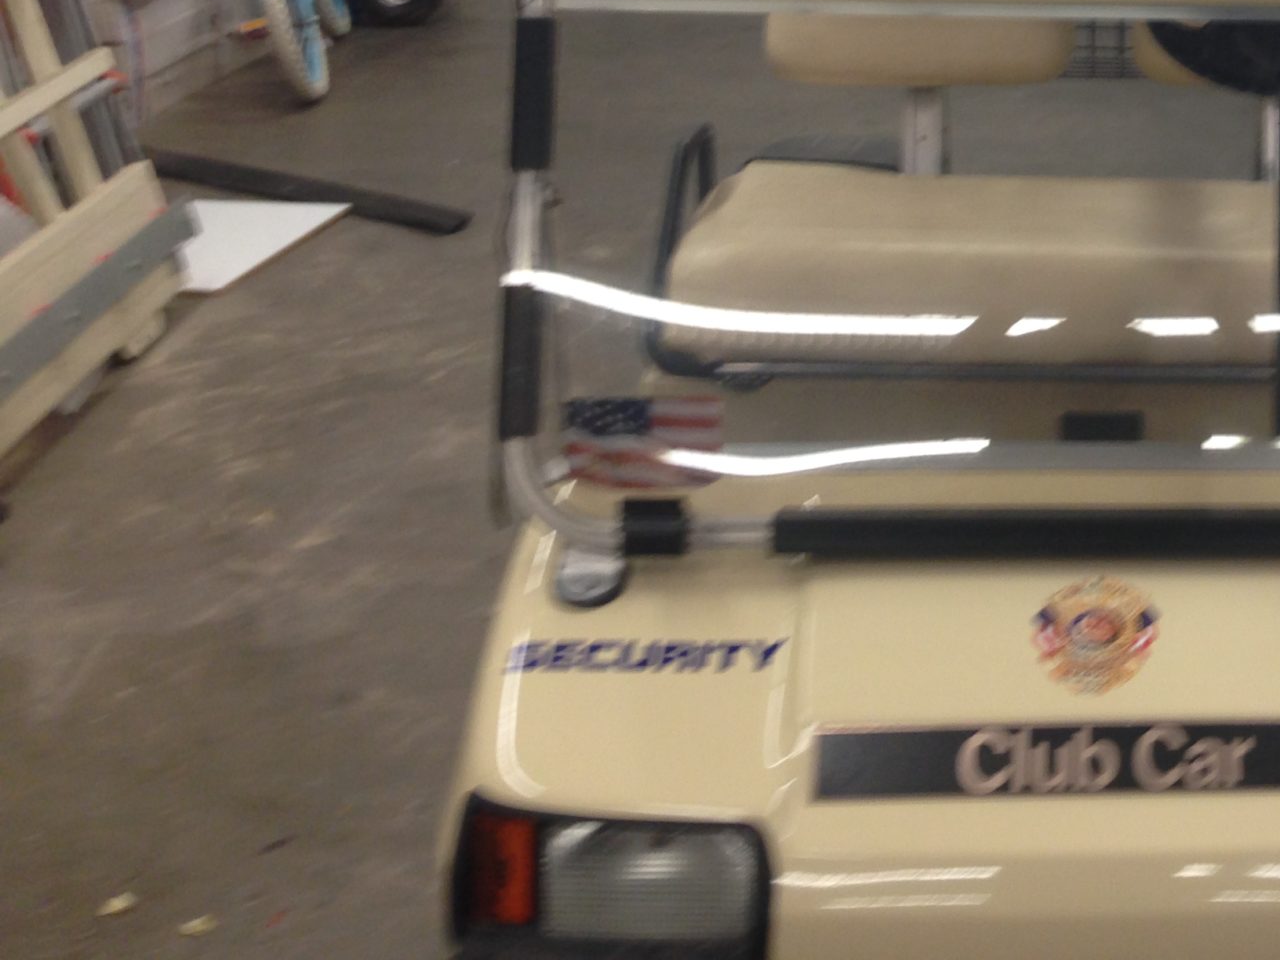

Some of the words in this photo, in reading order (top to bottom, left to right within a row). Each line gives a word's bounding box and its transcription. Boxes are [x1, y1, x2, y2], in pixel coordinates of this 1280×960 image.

[503, 636, 789, 673] SECURITY
[955, 724, 1122, 796] Club
[1131, 723, 1257, 792] Car
